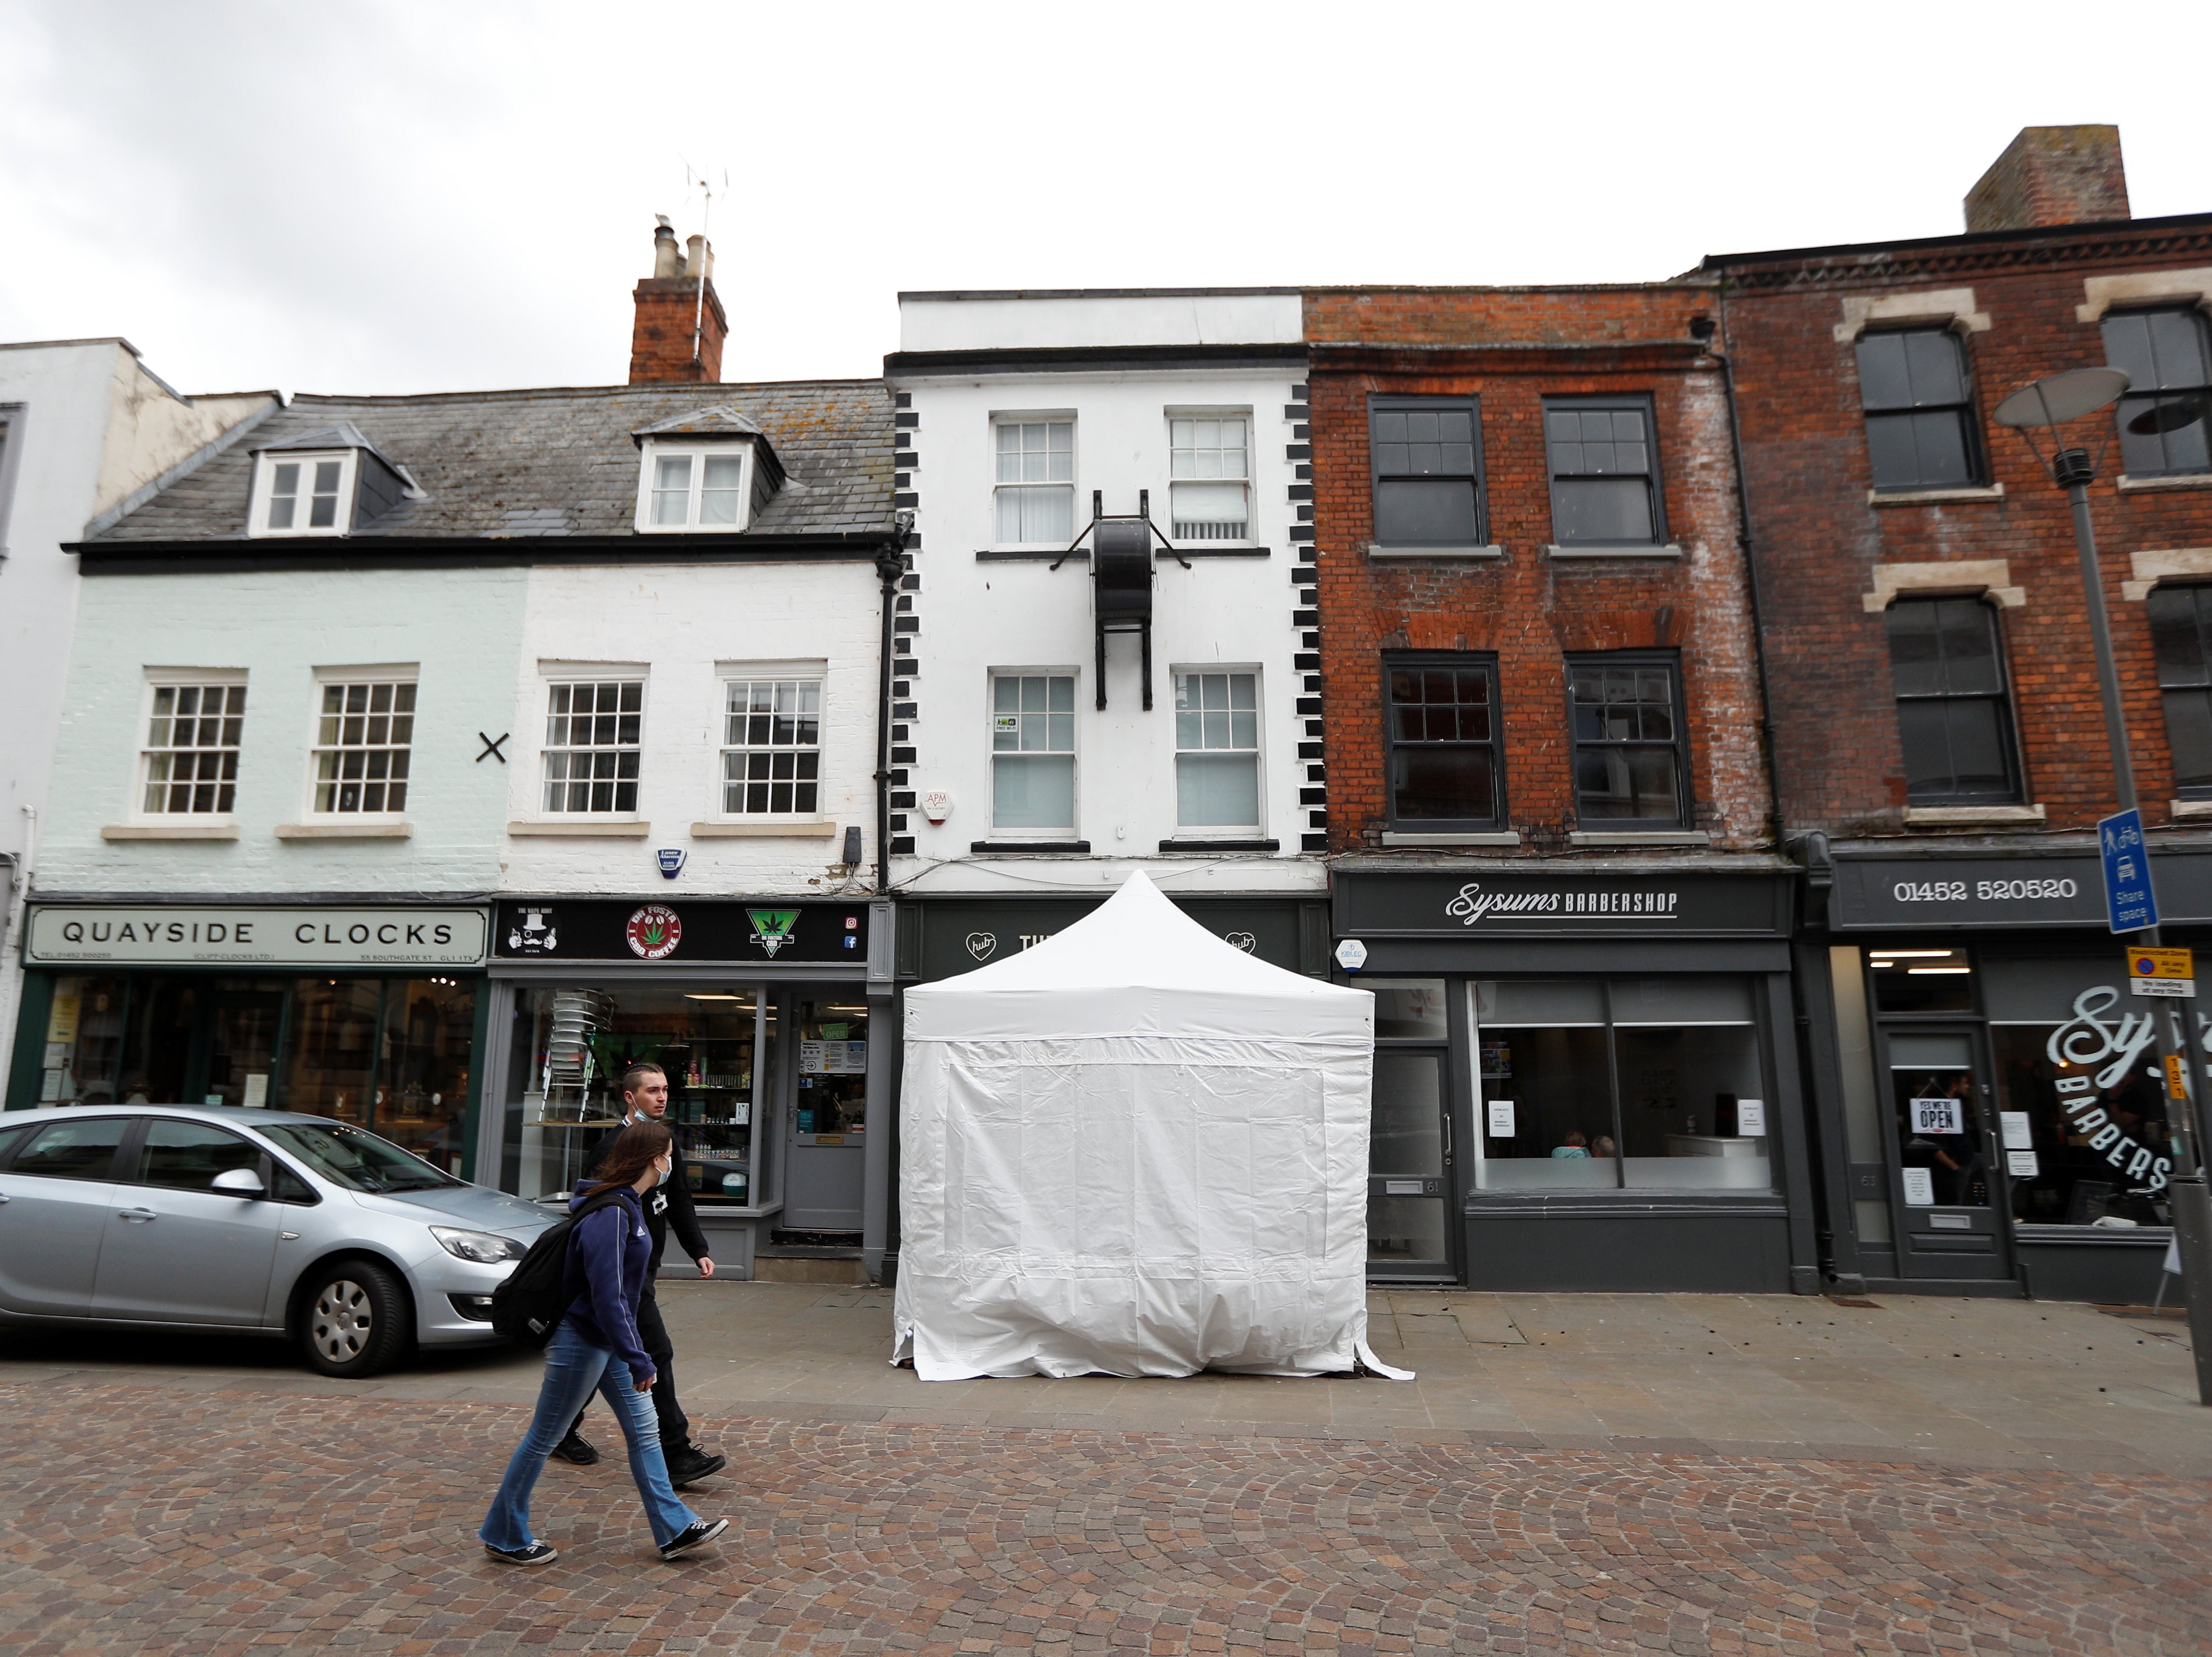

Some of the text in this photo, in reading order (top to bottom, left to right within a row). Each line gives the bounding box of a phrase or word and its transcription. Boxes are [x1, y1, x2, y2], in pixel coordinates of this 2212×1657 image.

[926, 794, 947, 804] APM
[1894, 878, 2077, 902] 01452 520520
[2116, 890, 2145, 905] Share
[1445, 883, 1677, 926] Sysums BARBERSHOP
[631, 906, 677, 924] DR FOSTA
[2118, 908, 2147, 923] space
[63, 922, 452, 945] QUAYSIDE CLOCKS
[630, 937, 678, 957] CBD COFFEE
[973, 937, 991, 953] hub
[826, 1030, 845, 1038] OPEN
[1919, 1101, 1931, 1110] YES
[1921, 1111, 1953, 1128] OPEN
[1427, 1182, 1438, 1192] 61
